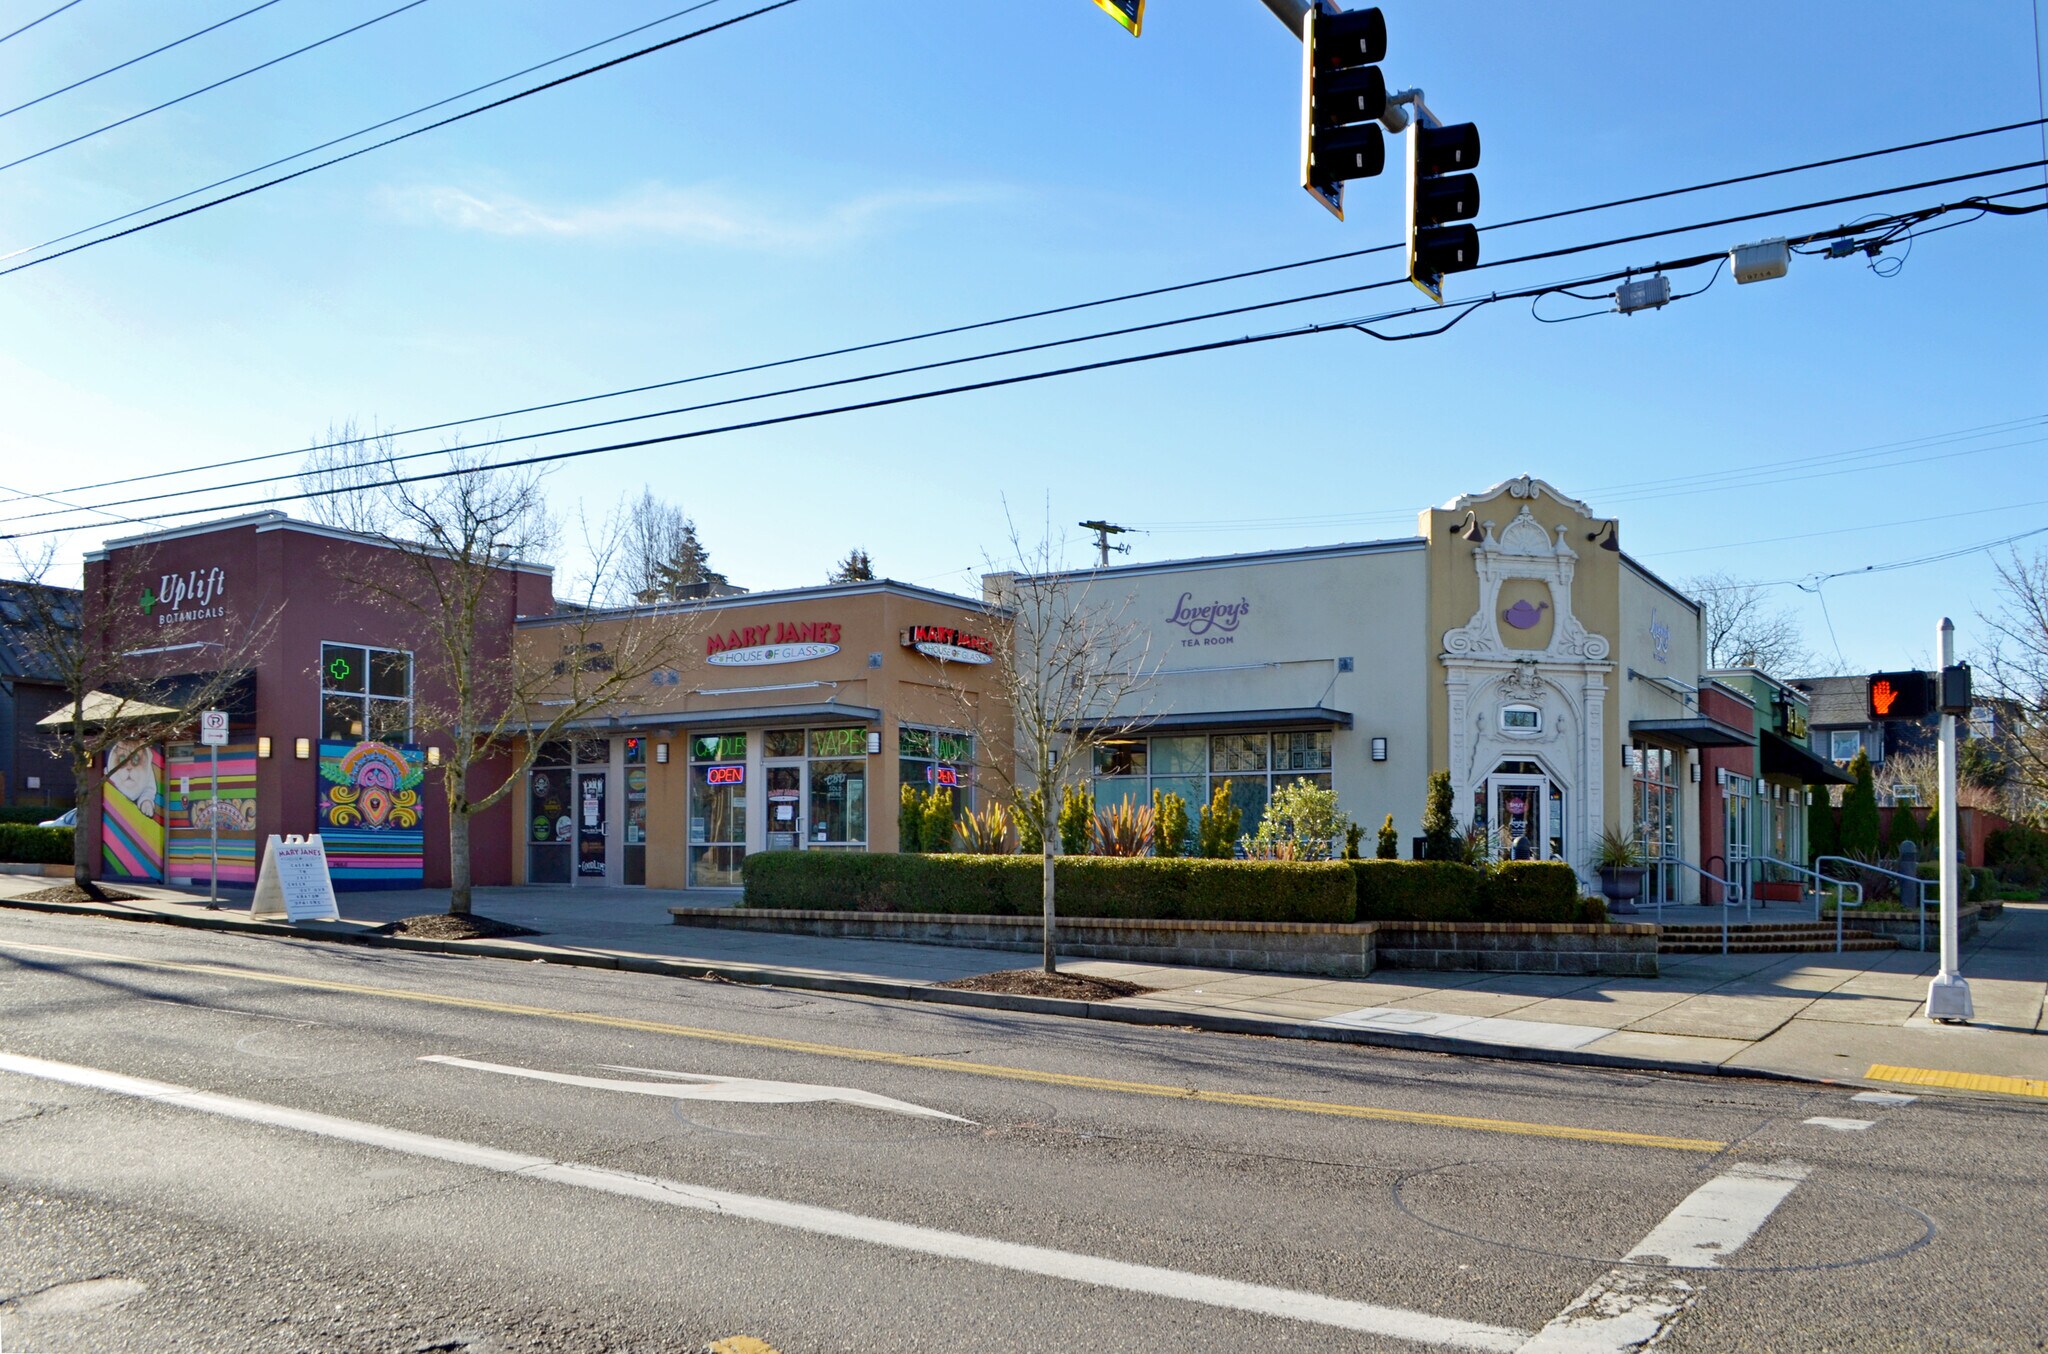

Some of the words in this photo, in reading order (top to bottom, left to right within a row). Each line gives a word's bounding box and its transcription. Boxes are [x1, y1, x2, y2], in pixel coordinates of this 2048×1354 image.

[160, 567, 225, 611] Uplift
[159, 607, 224, 625] BOTANICALS
[1165, 592, 1249, 635] Lovejoy's
[707, 624, 771, 655] MARY
[775, 622, 841, 645] JANE'S
[914, 627, 955, 644] MARY
[1181, 639, 1201, 648] TEA
[1203, 636, 1234, 646] ROOM
[725, 651, 762, 662] HOUSE
[764, 649, 780, 660] OF
[782, 645, 818, 658] GLASS
[709, 768, 742, 783] OPEN
[279, 848, 299, 857] MARY
